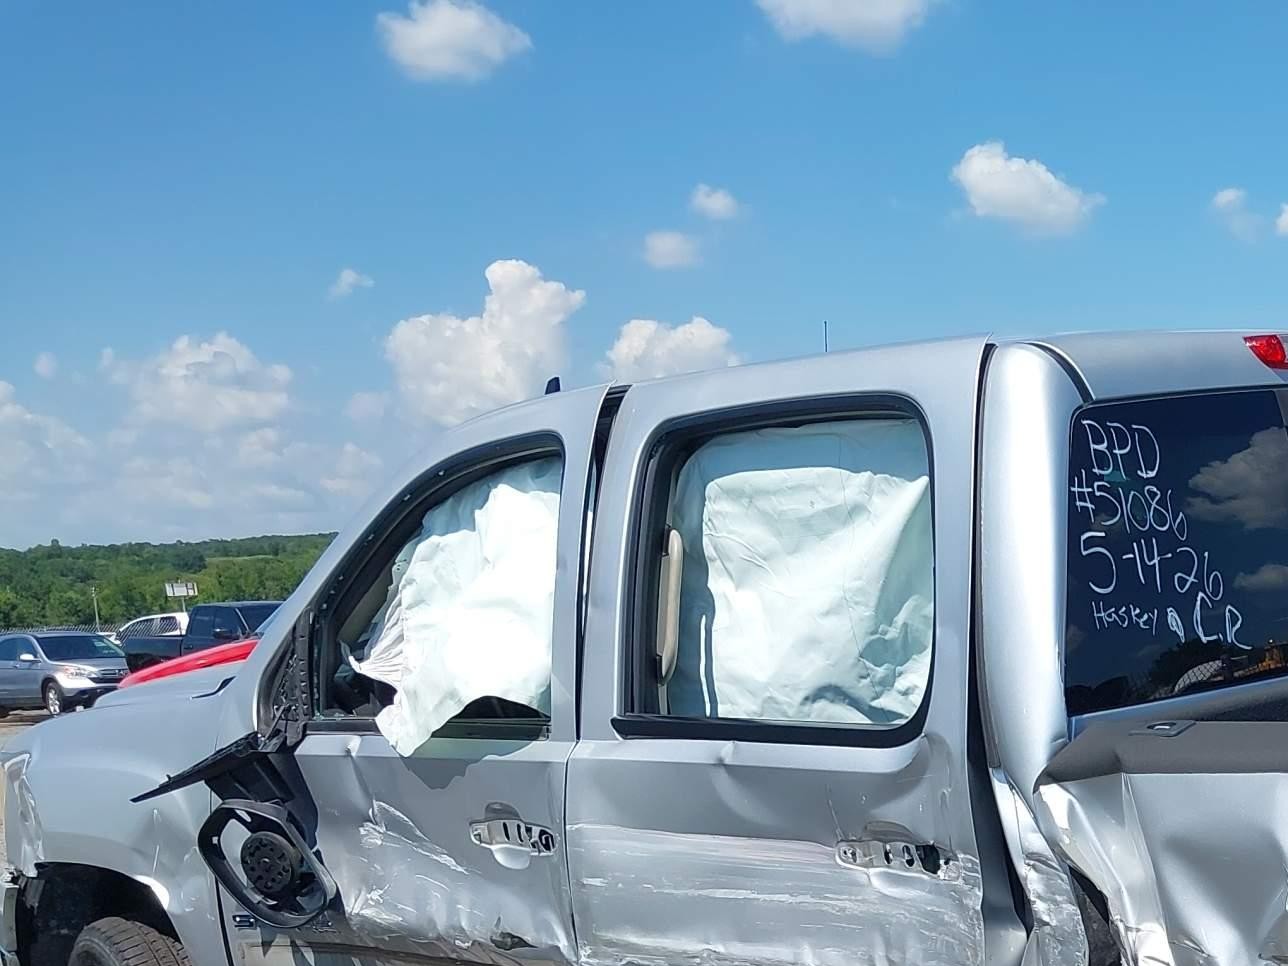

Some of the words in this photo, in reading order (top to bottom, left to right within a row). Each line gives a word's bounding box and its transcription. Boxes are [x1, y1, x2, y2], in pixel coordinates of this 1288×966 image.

[1081, 418, 1160, 480] BPD
[1070, 469, 1188, 541] #51086
[1080, 531, 1224, 601] 5-14-26
